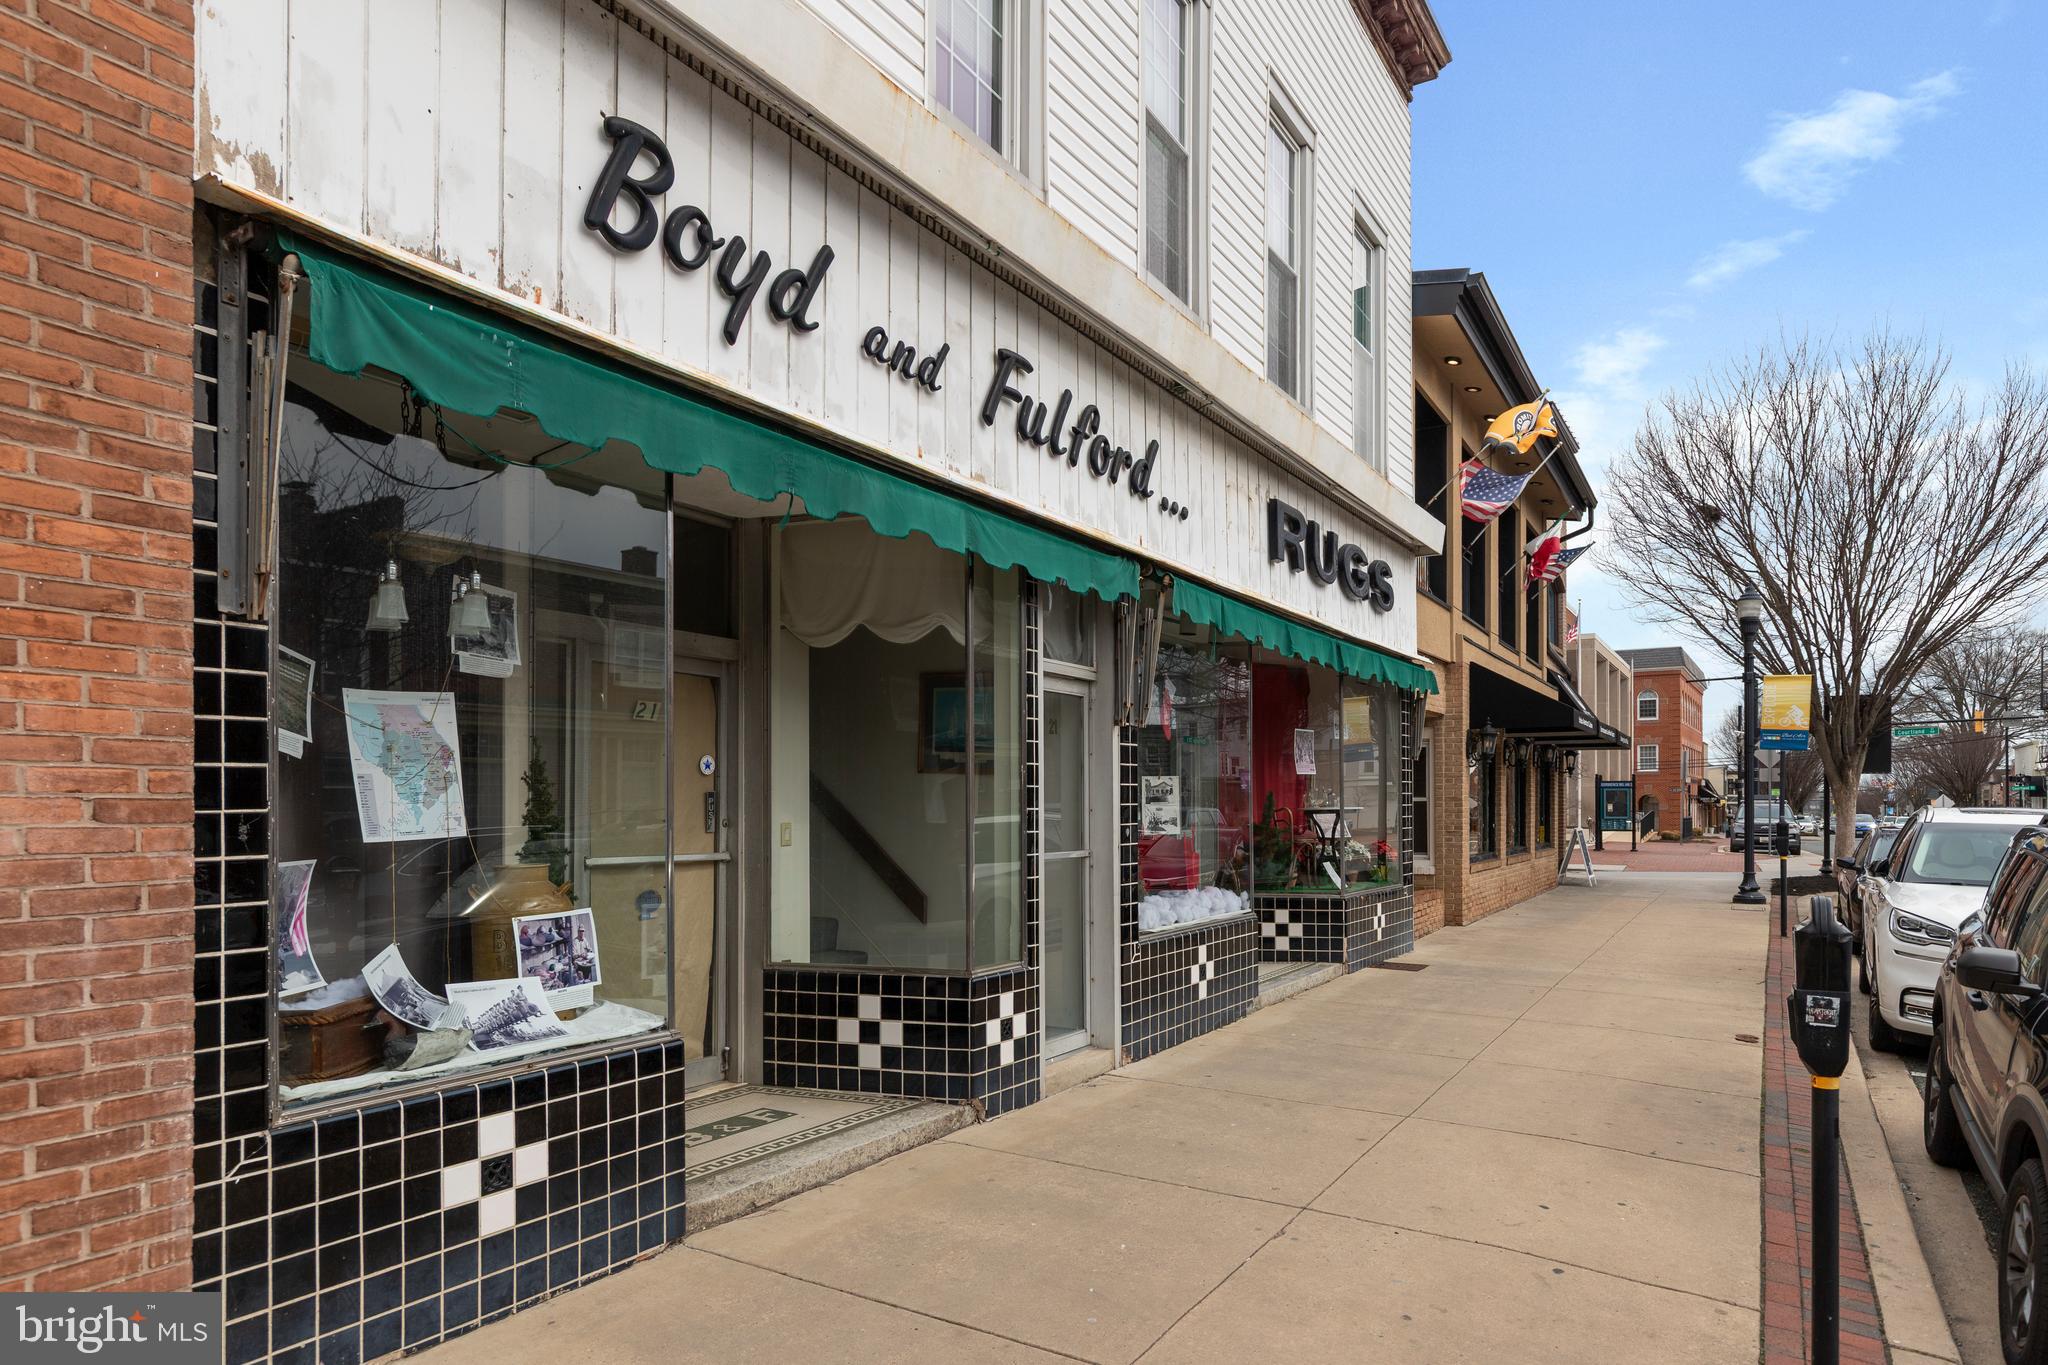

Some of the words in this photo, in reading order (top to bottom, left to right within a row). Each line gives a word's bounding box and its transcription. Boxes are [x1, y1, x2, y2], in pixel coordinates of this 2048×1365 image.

[584, 116, 834, 346] Boyd
[862, 326, 950, 392] and
[1268, 498, 1395, 612] RUGS
[635, 702, 658, 719] 21
